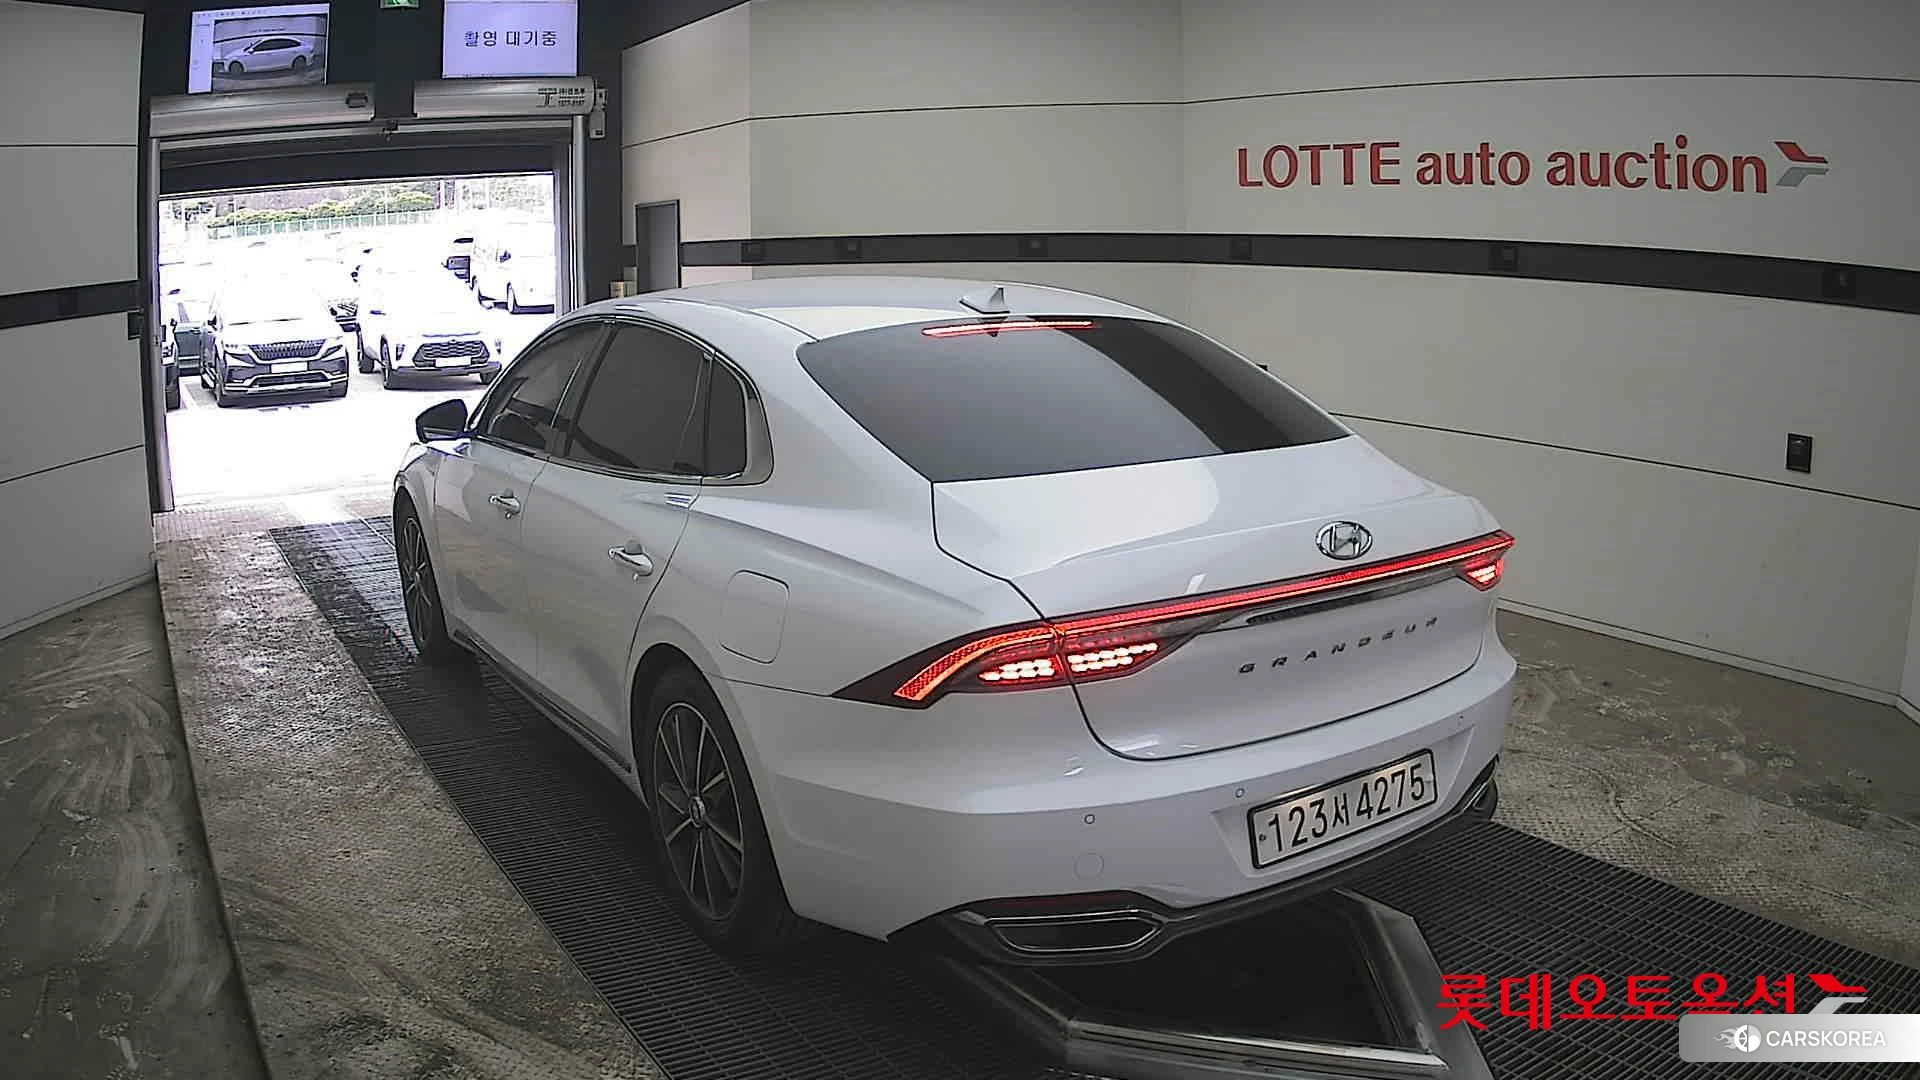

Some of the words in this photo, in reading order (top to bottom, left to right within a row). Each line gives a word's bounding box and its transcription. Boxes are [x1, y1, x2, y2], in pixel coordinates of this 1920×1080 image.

[505, 31, 558, 47] 대기중
[1236, 141, 1401, 188] LOTTE
[1415, 142, 1530, 186] auto
[1546, 134, 1768, 193] auction
[1239, 616, 1437, 673] GRANDEUR
